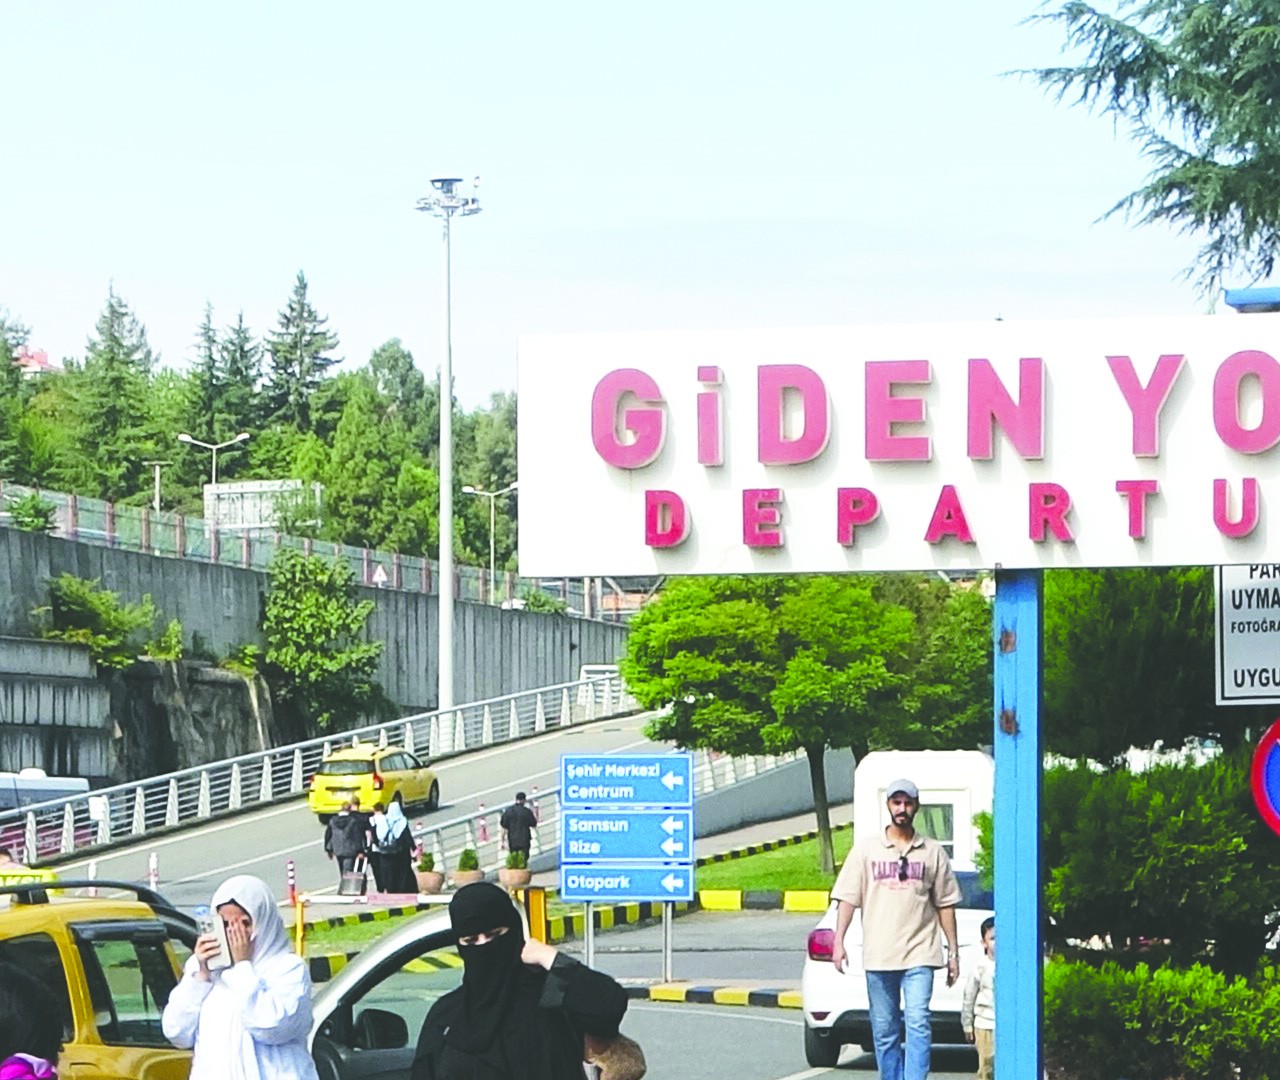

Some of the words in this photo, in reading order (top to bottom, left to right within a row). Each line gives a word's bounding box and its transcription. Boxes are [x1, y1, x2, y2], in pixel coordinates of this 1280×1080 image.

[567, 764, 602, 779] Şehir
[605, 763, 660, 777] Merkezi
[567, 785, 634, 799] Centrum
[569, 818, 629, 832] Samsun
[569, 840, 601, 854] Rize
[871, 860, 926, 881] CALIFNIA
[567, 876, 631, 891] Otopark
